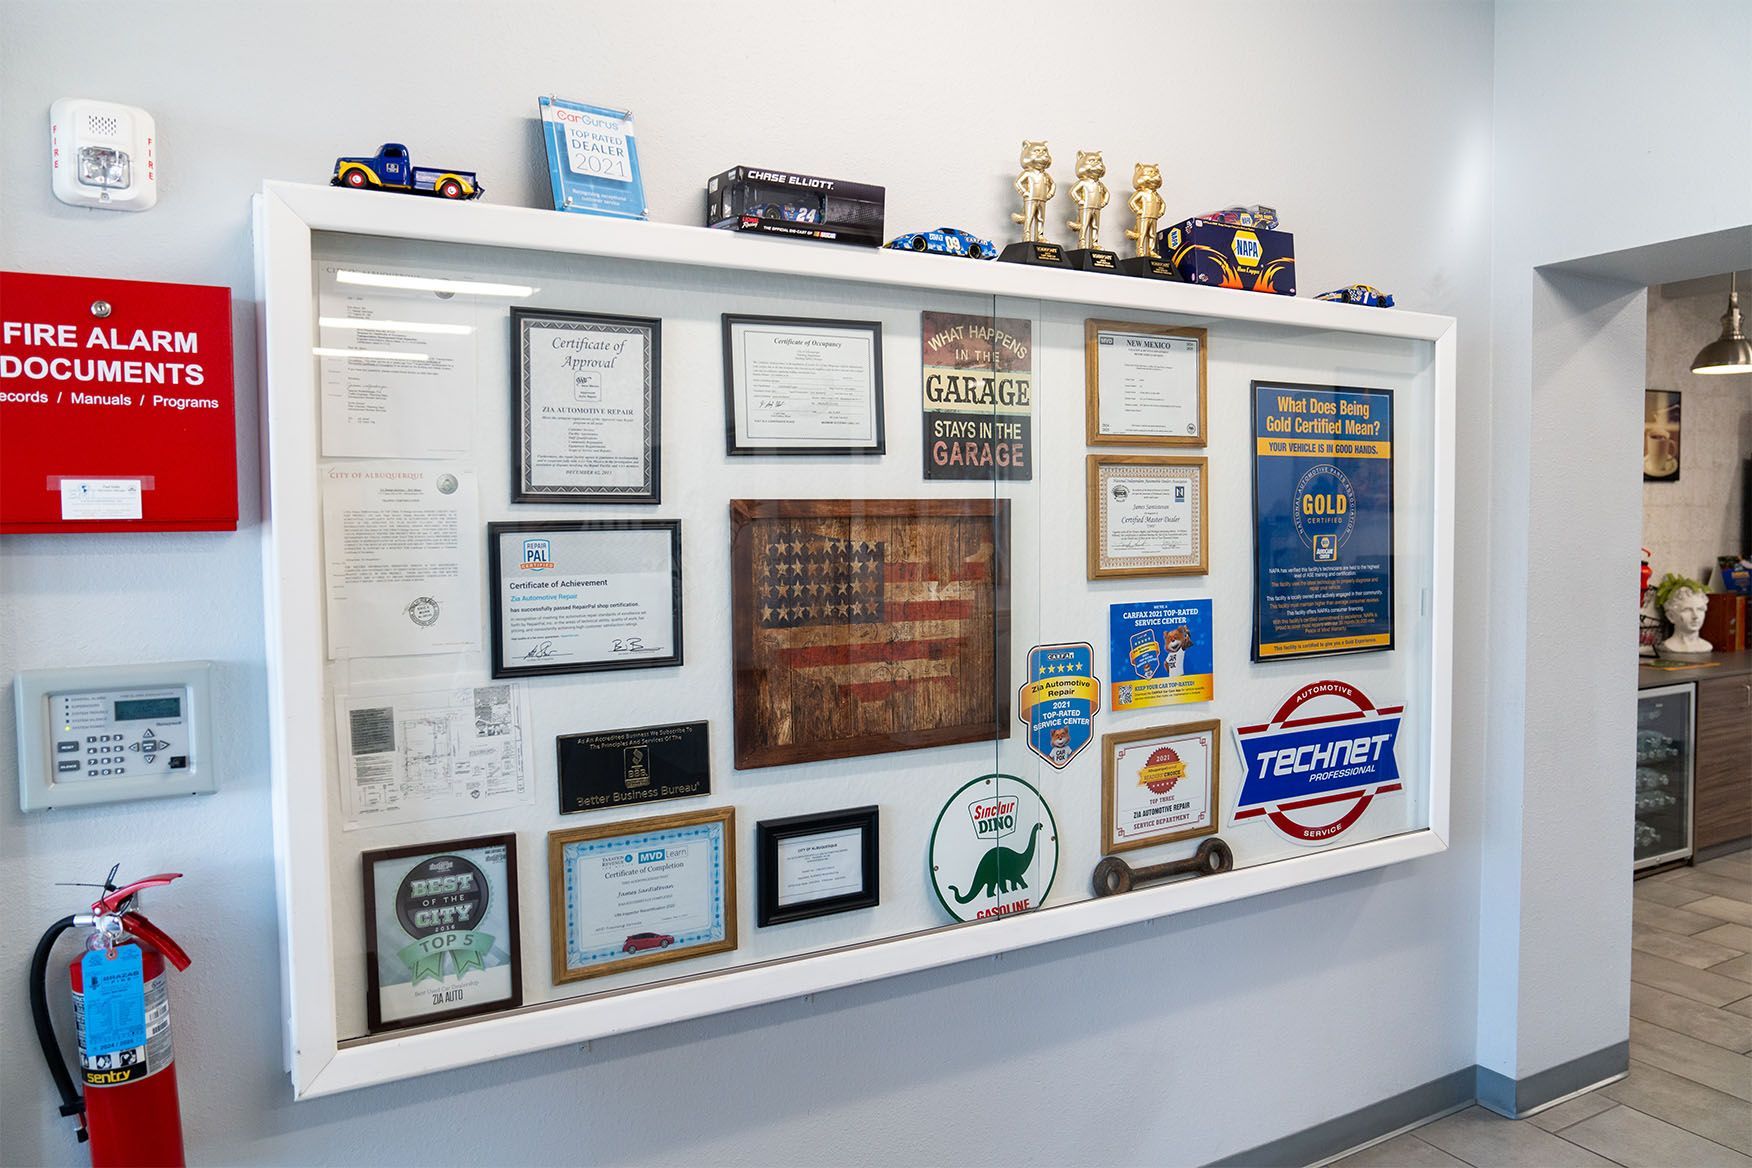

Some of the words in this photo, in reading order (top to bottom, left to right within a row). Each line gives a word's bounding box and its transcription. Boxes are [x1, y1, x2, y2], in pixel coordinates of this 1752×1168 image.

[556, 110, 619, 131] CarGurus
[571, 129, 589, 139] TOP
[592, 133, 622, 146] RATED
[572, 139, 625, 158] DEALER
[575, 152, 624, 178] 2021
[748, 170, 786, 184] CHASE
[796, 208, 816, 222] 24
[944, 236, 962, 250] 09
[1171, 229, 1179, 248] NAPA
[1236, 239, 1260, 258] NAPA
[4, 322, 78, 348] FIRE
[86, 327, 198, 354] ALARM
[774, 338, 803, 346] Certificate
[804, 338, 812, 346] of
[812, 340, 842, 349] Occupancy
[928, 326, 965, 352] WHAT
[969, 325, 1028, 360] HAPPENS
[1144, 340, 1171, 350] MEXICO
[552, 336, 610, 352] Certificate
[613, 340, 628, 355] of
[561, 355, 618, 371] Approval
[956, 349, 968, 360] IN
[974, 350, 1000, 363] THE
[0, 356, 204, 386] DOCUMENTS
[926, 374, 1030, 406] GARAGE
[0, 391, 48, 403] ecords
[57, 392, 62, 404] /
[71, 392, 132, 406] Manuals
[140, 395, 145, 406] /
[154, 396, 219, 410] Programs
[542, 406, 555, 414] ZIA
[1277, 396, 1307, 412] What
[1310, 398, 1336, 414] Does
[1340, 400, 1370, 420] Being
[934, 420, 976, 438] STAYS
[979, 422, 992, 439] IN
[996, 423, 1022, 440] THE
[1266, 416, 1291, 432] Gold
[1295, 418, 1342, 434] Certified
[1346, 420, 1380, 436] Mean?
[934, 440, 1024, 467] GARAGE
[1268, 442, 1286, 452] YOUR
[1288, 442, 1316, 453] VEHICLE
[1318, 444, 1324, 453] IS
[1326, 444, 1334, 453] IN
[1336, 444, 1352, 454] GOOD
[1354, 445, 1378, 454] HANDS.
[330, 472, 350, 480] CITY
[352, 472, 362, 480] OF
[1302, 494, 1347, 514] GOLD
[1122, 515, 1144, 525] Certified
[1144, 515, 1163, 523] Master
[526, 542, 547, 550] REPAIR
[527, 550, 547, 562] PAL
[510, 581, 549, 590] Certificate
[550, 580, 559, 588] of
[560, 579, 608, 588] Achievement
[522, 594, 557, 602] Automotive
[558, 594, 578, 602] Repair
[554, 604, 571, 612] passed
[597, 602, 608, 610] shop
[1123, 612, 1148, 620] CARFAX
[1163, 608, 1198, 617] TOP-RATED
[1135, 618, 1161, 626] SERVICE
[1048, 652, 1074, 660] CARFAX
[1032, 684, 1044, 694] Zia
[1046, 680, 1090, 689] Automotive
[1048, 688, 1075, 697] Repair
[1296, 684, 1353, 703] AUTOMOTIVE
[1052, 701, 1070, 710] 2021
[1042, 710, 1081, 720] TOP-RATED
[1033, 718, 1062, 732] SERVICE
[1063, 718, 1090, 726] CENTER
[595, 734, 624, 742] Accredited
[660, 728, 686, 736] Subscribe
[602, 742, 628, 750] Principles
[642, 737, 664, 745] Services
[1308, 764, 1376, 783] PROFESSIONAL
[577, 794, 610, 806] Better
[613, 788, 658, 802] Business
[661, 784, 698, 796] Bureau
[974, 801, 1016, 820] Sinclair
[1142, 804, 1172, 816] AUTOMOTIVE
[1173, 802, 1190, 811] REPAIR
[978, 815, 1014, 834] DINO
[1134, 822, 1155, 830] SERVICE
[1156, 814, 1190, 826] DEPARTMENT
[1304, 824, 1342, 838] SERVICE
[640, 851, 663, 862] MVD
[666, 849, 687, 858] Learn
[604, 870, 638, 880] Certificate
[647, 862, 684, 874] Completion
[411, 872, 474, 898] BEST
[422, 898, 436, 907] OF
[444, 894, 465, 903] THE
[414, 904, 473, 929] CITY
[435, 924, 456, 932] 2016
[420, 934, 456, 953] TOP
[464, 934, 474, 946] 5
[432, 993, 444, 1005] ZIA
[445, 989, 464, 1002] AUTO
[87, 1070, 131, 1083] sentry
